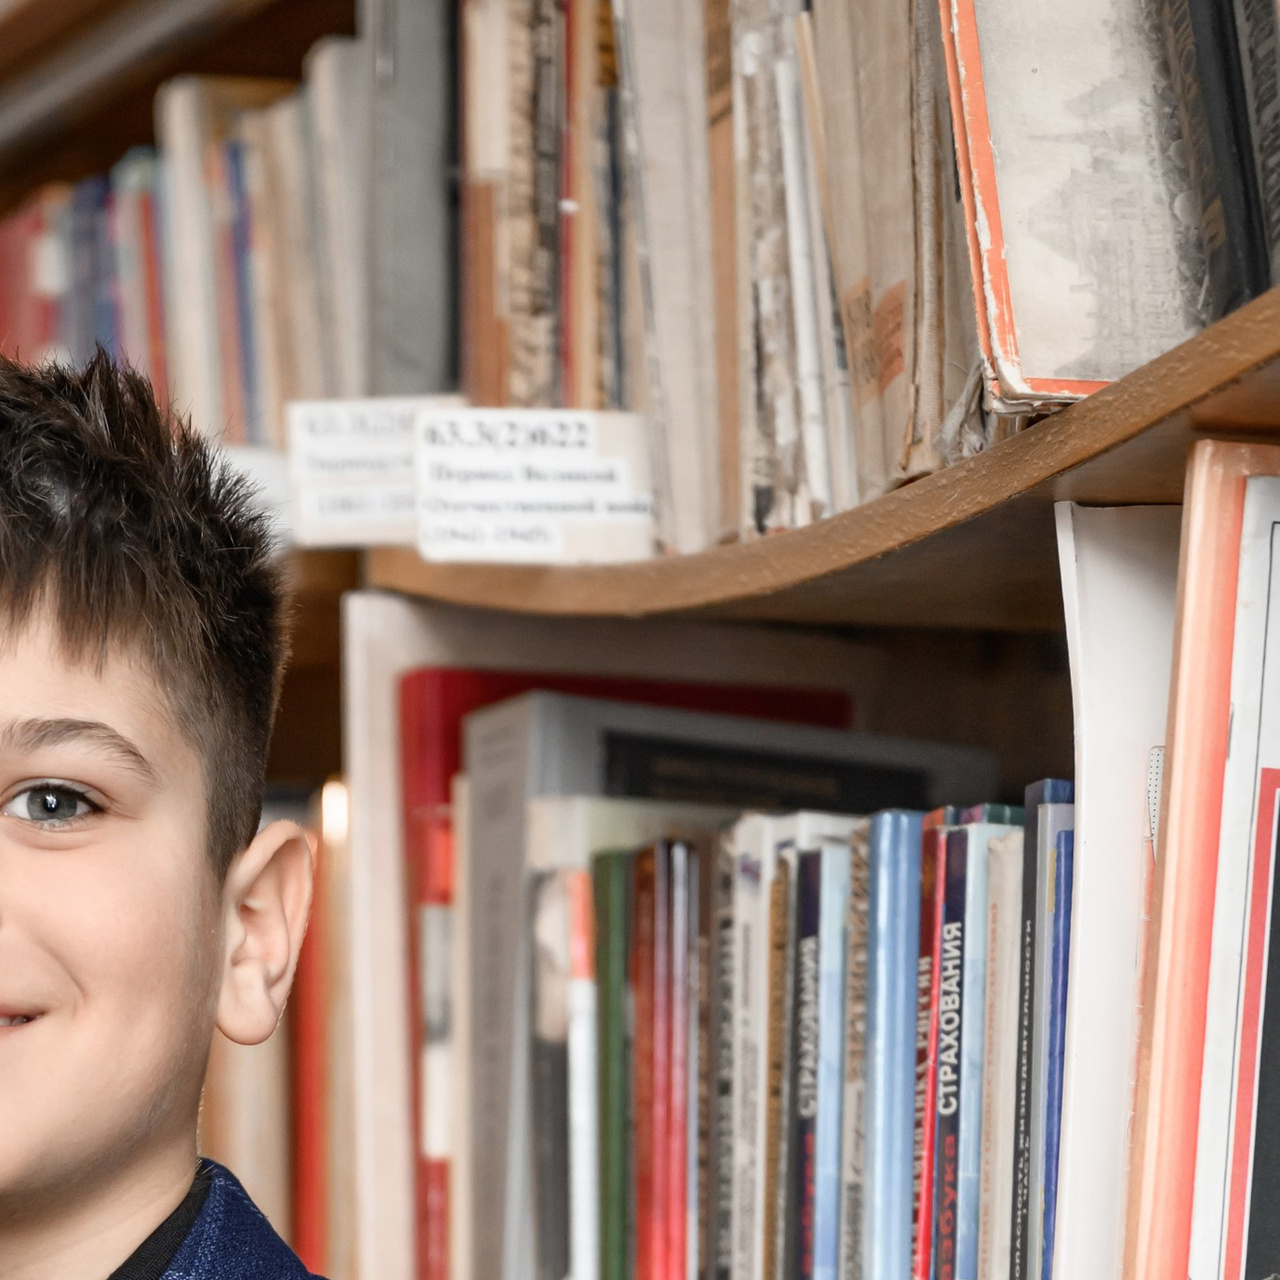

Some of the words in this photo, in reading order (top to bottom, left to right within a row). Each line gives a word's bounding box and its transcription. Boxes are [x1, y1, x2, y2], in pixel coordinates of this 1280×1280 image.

[938, 921, 962, 1118] СТРАХОВАНИЯ
[1019, 920, 1031, 1151] ЖИЗНЕДЕЯТЕЛЬНОСТИ
[1022, 1135, 1030, 1201] ЧАСТЬ
